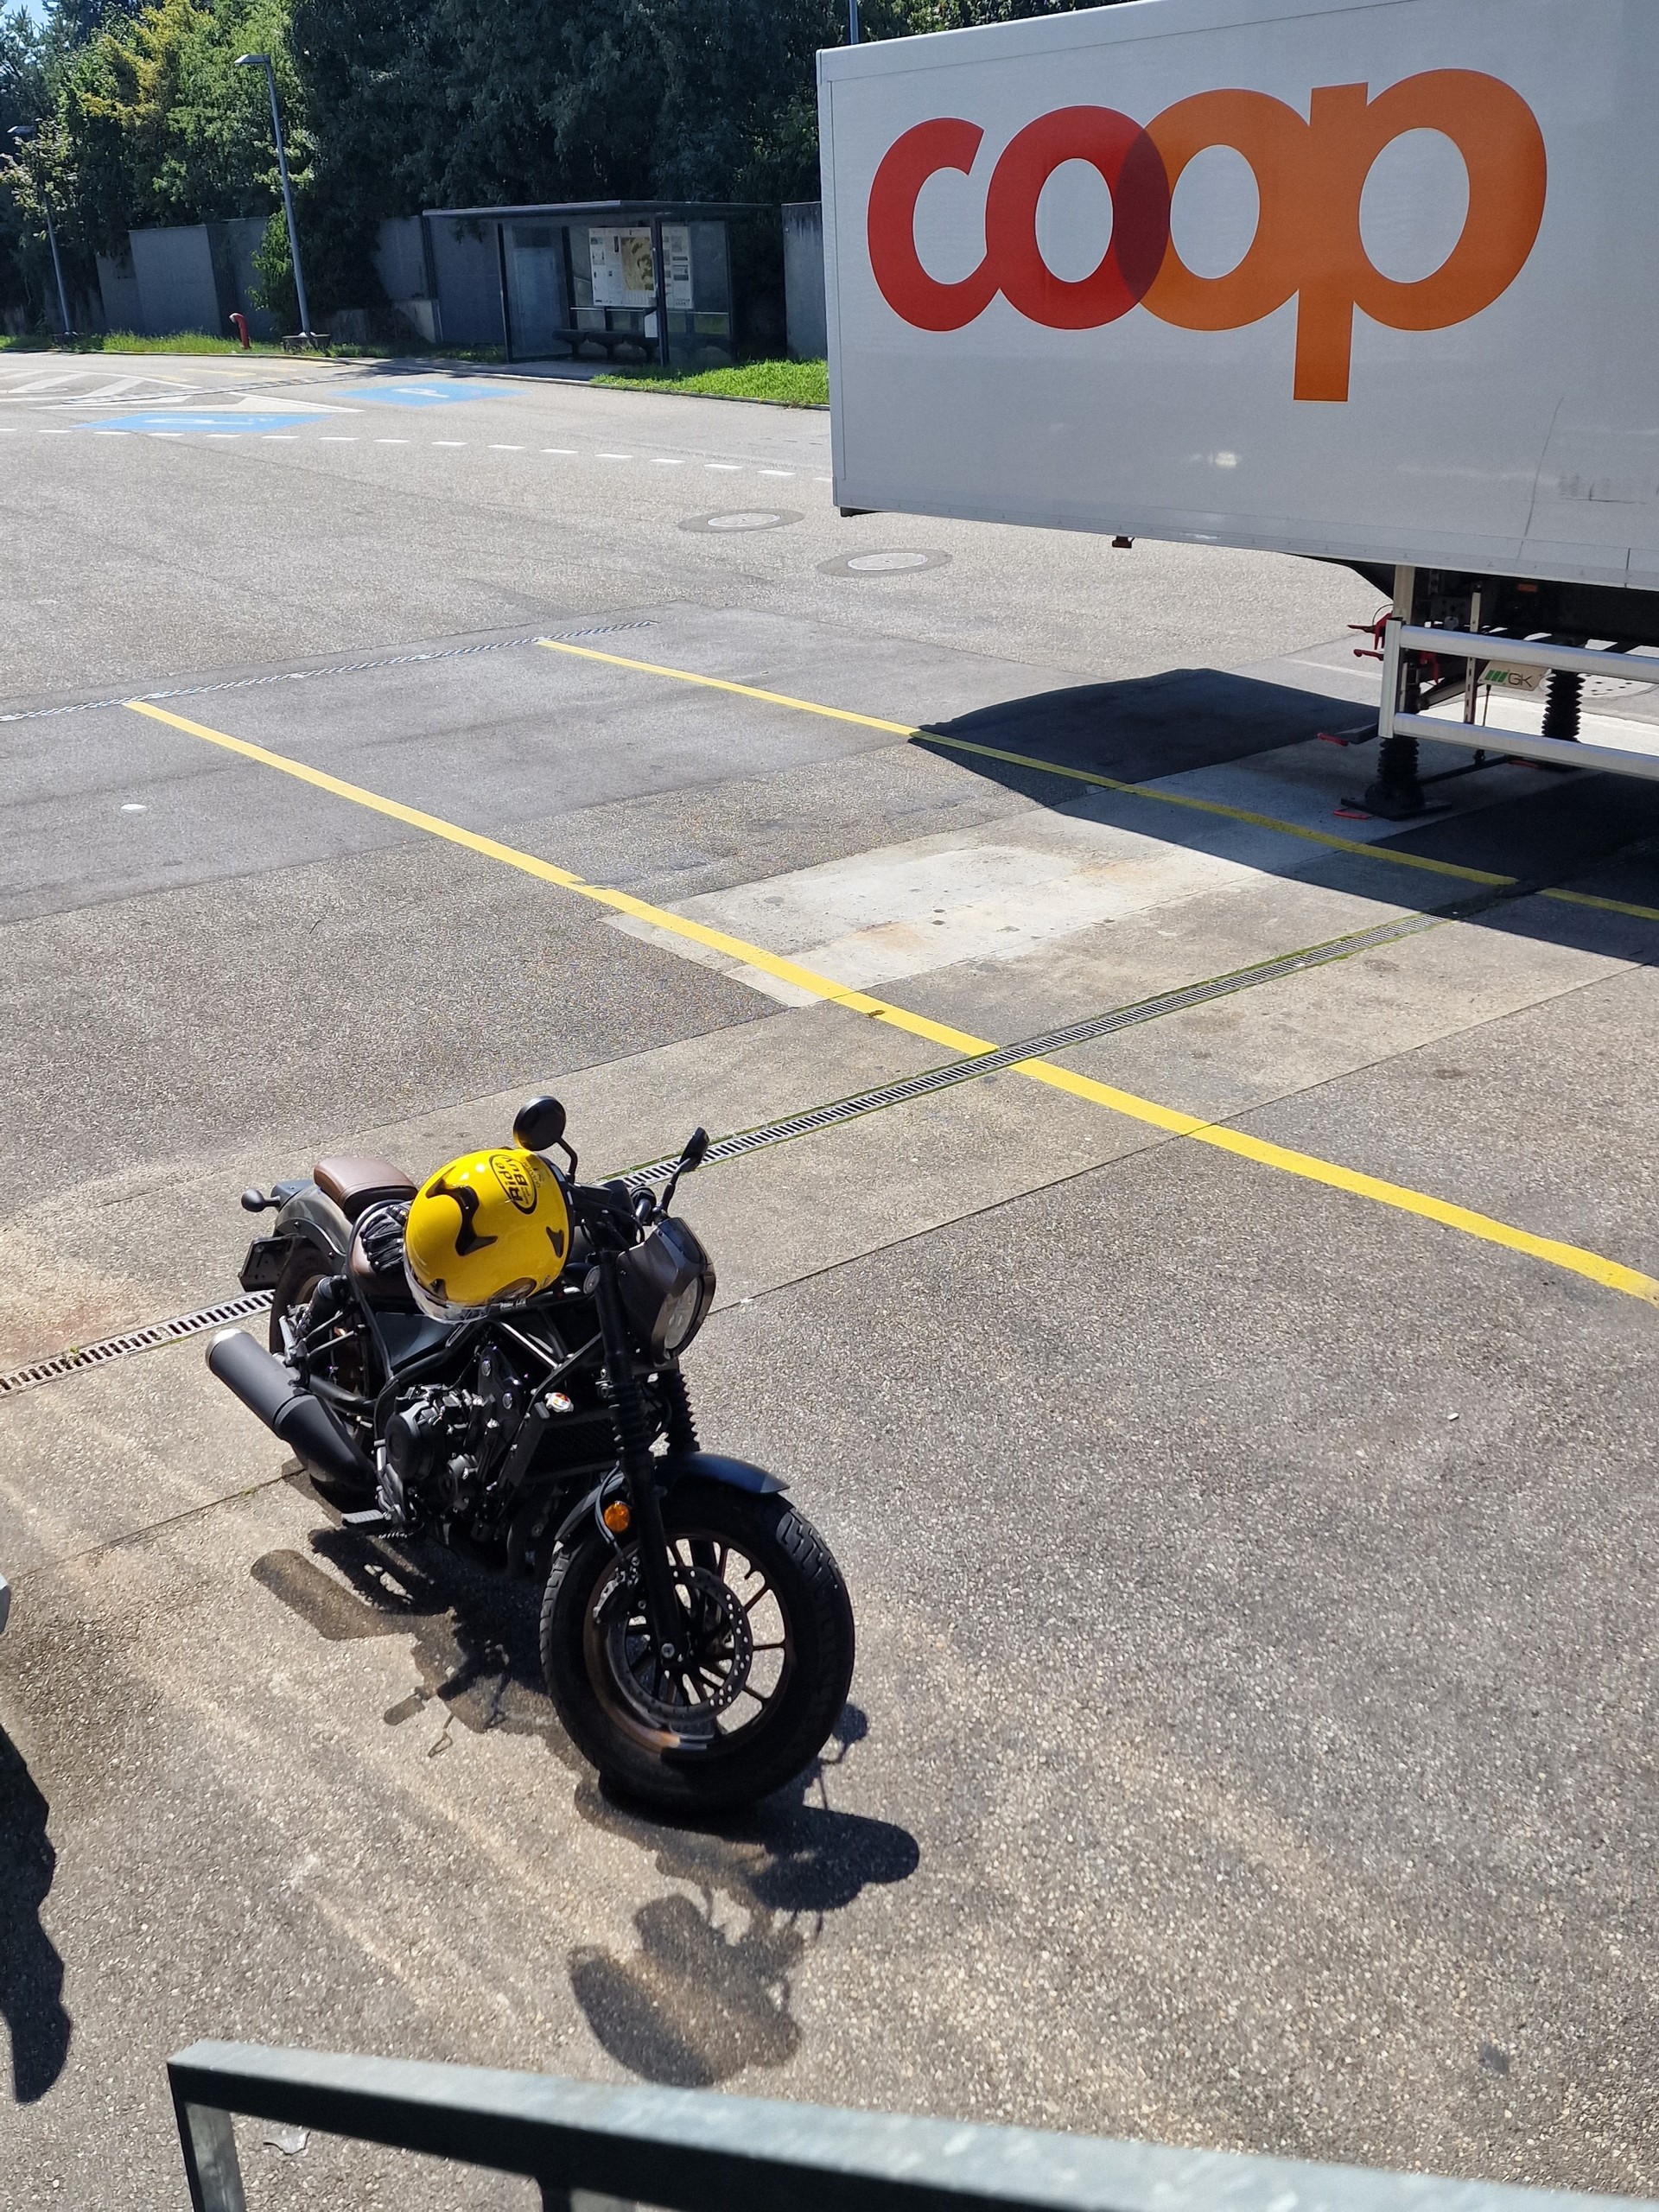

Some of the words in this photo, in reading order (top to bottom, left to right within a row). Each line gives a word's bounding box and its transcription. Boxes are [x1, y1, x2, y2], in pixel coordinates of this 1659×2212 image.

[867, 67, 1548, 402] coop
[1509, 672, 1532, 687] GK
[495, 1162, 523, 1201] Ride
